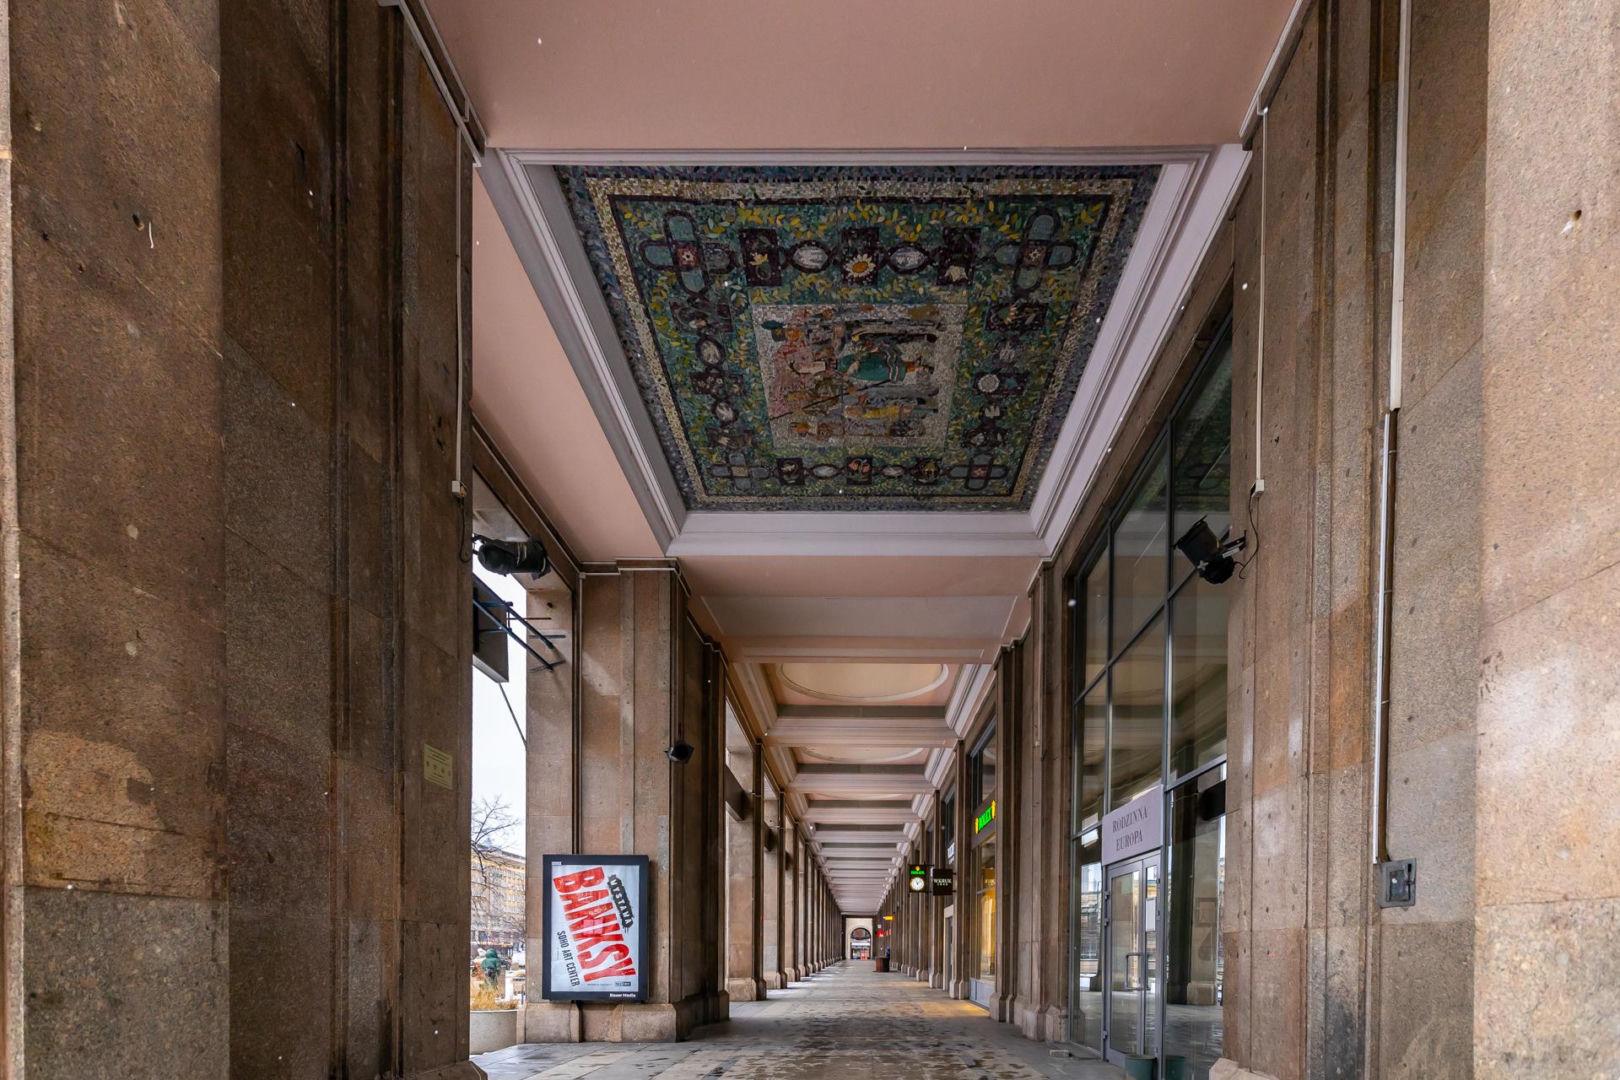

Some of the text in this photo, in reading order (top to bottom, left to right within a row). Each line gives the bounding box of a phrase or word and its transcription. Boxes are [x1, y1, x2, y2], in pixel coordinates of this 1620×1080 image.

[1112, 807, 1148, 833] RODZINNA
[1116, 830, 1143, 851] EUROPA
[553, 866, 636, 982] BANKSY
[610, 879, 632, 924] WYSTAWA
[557, 930, 580, 987] SOHO ART CENTER
